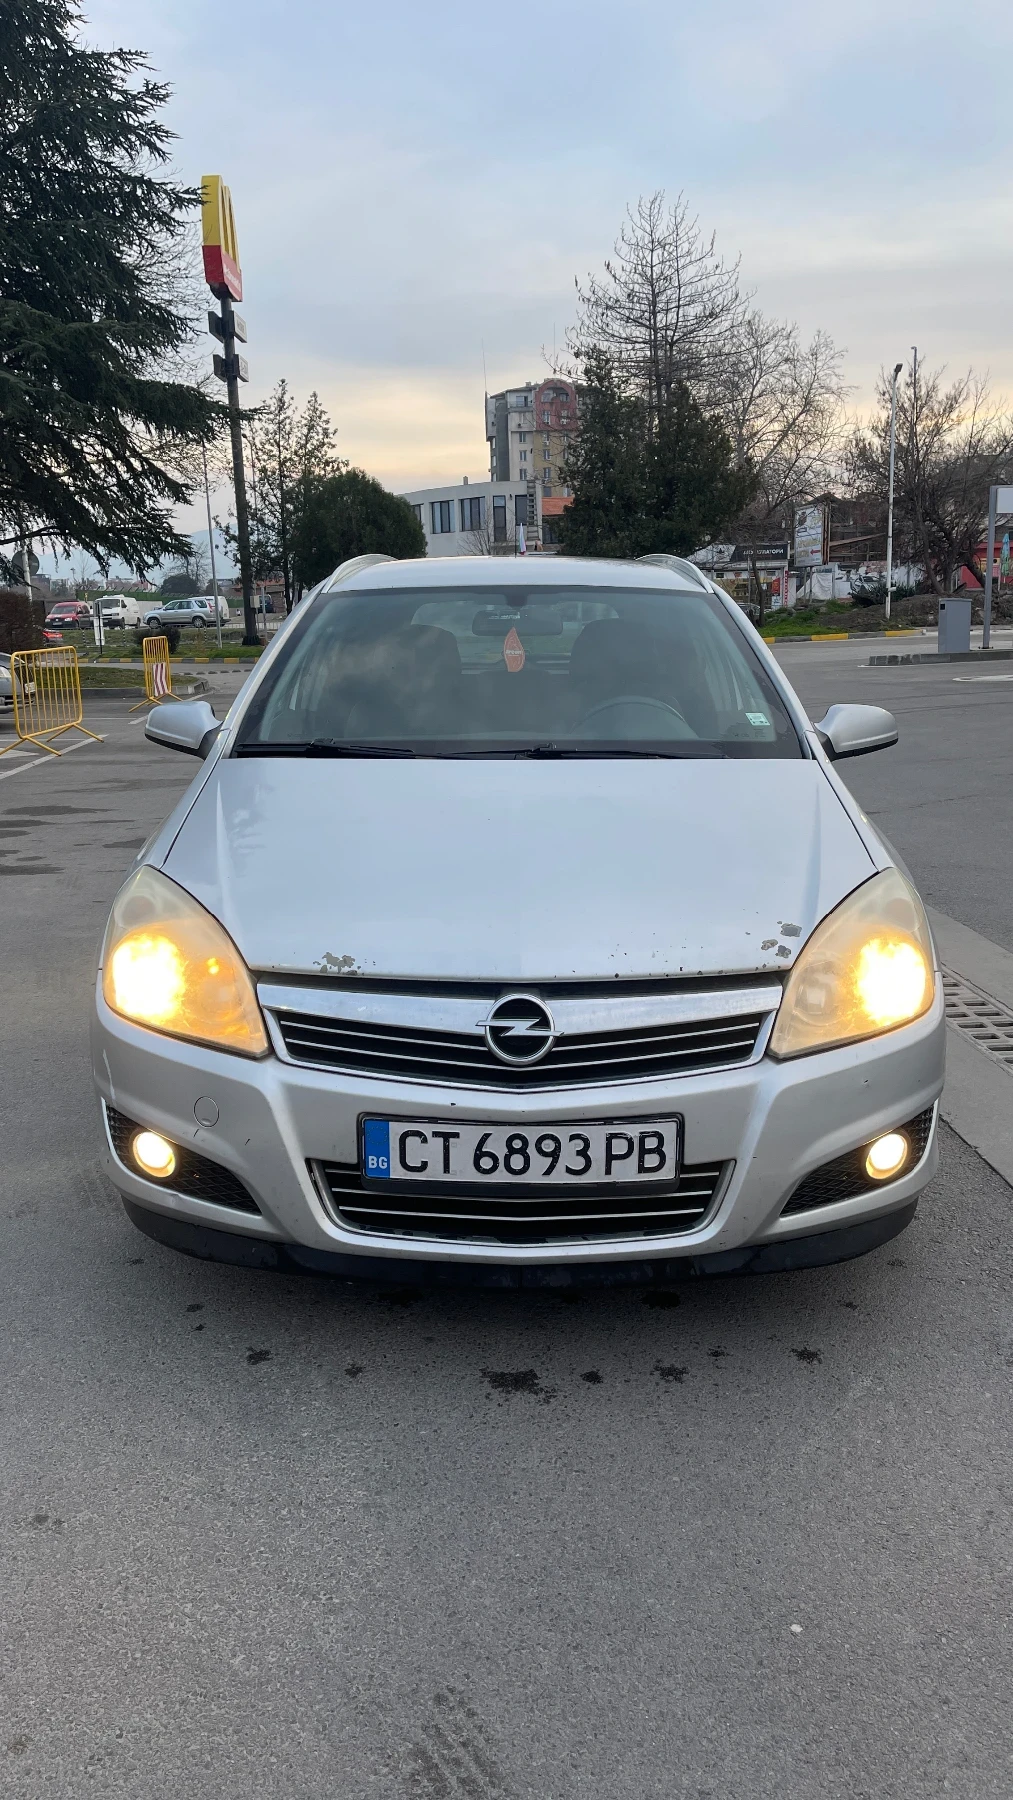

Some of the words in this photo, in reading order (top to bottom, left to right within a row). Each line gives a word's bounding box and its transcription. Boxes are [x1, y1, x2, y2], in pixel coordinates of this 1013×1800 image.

[368, 1155, 388, 1169] BG
[398, 1129, 460, 1175] CT
[473, 1132, 593, 1176] 6893
[604, 1130, 667, 1175] PB
